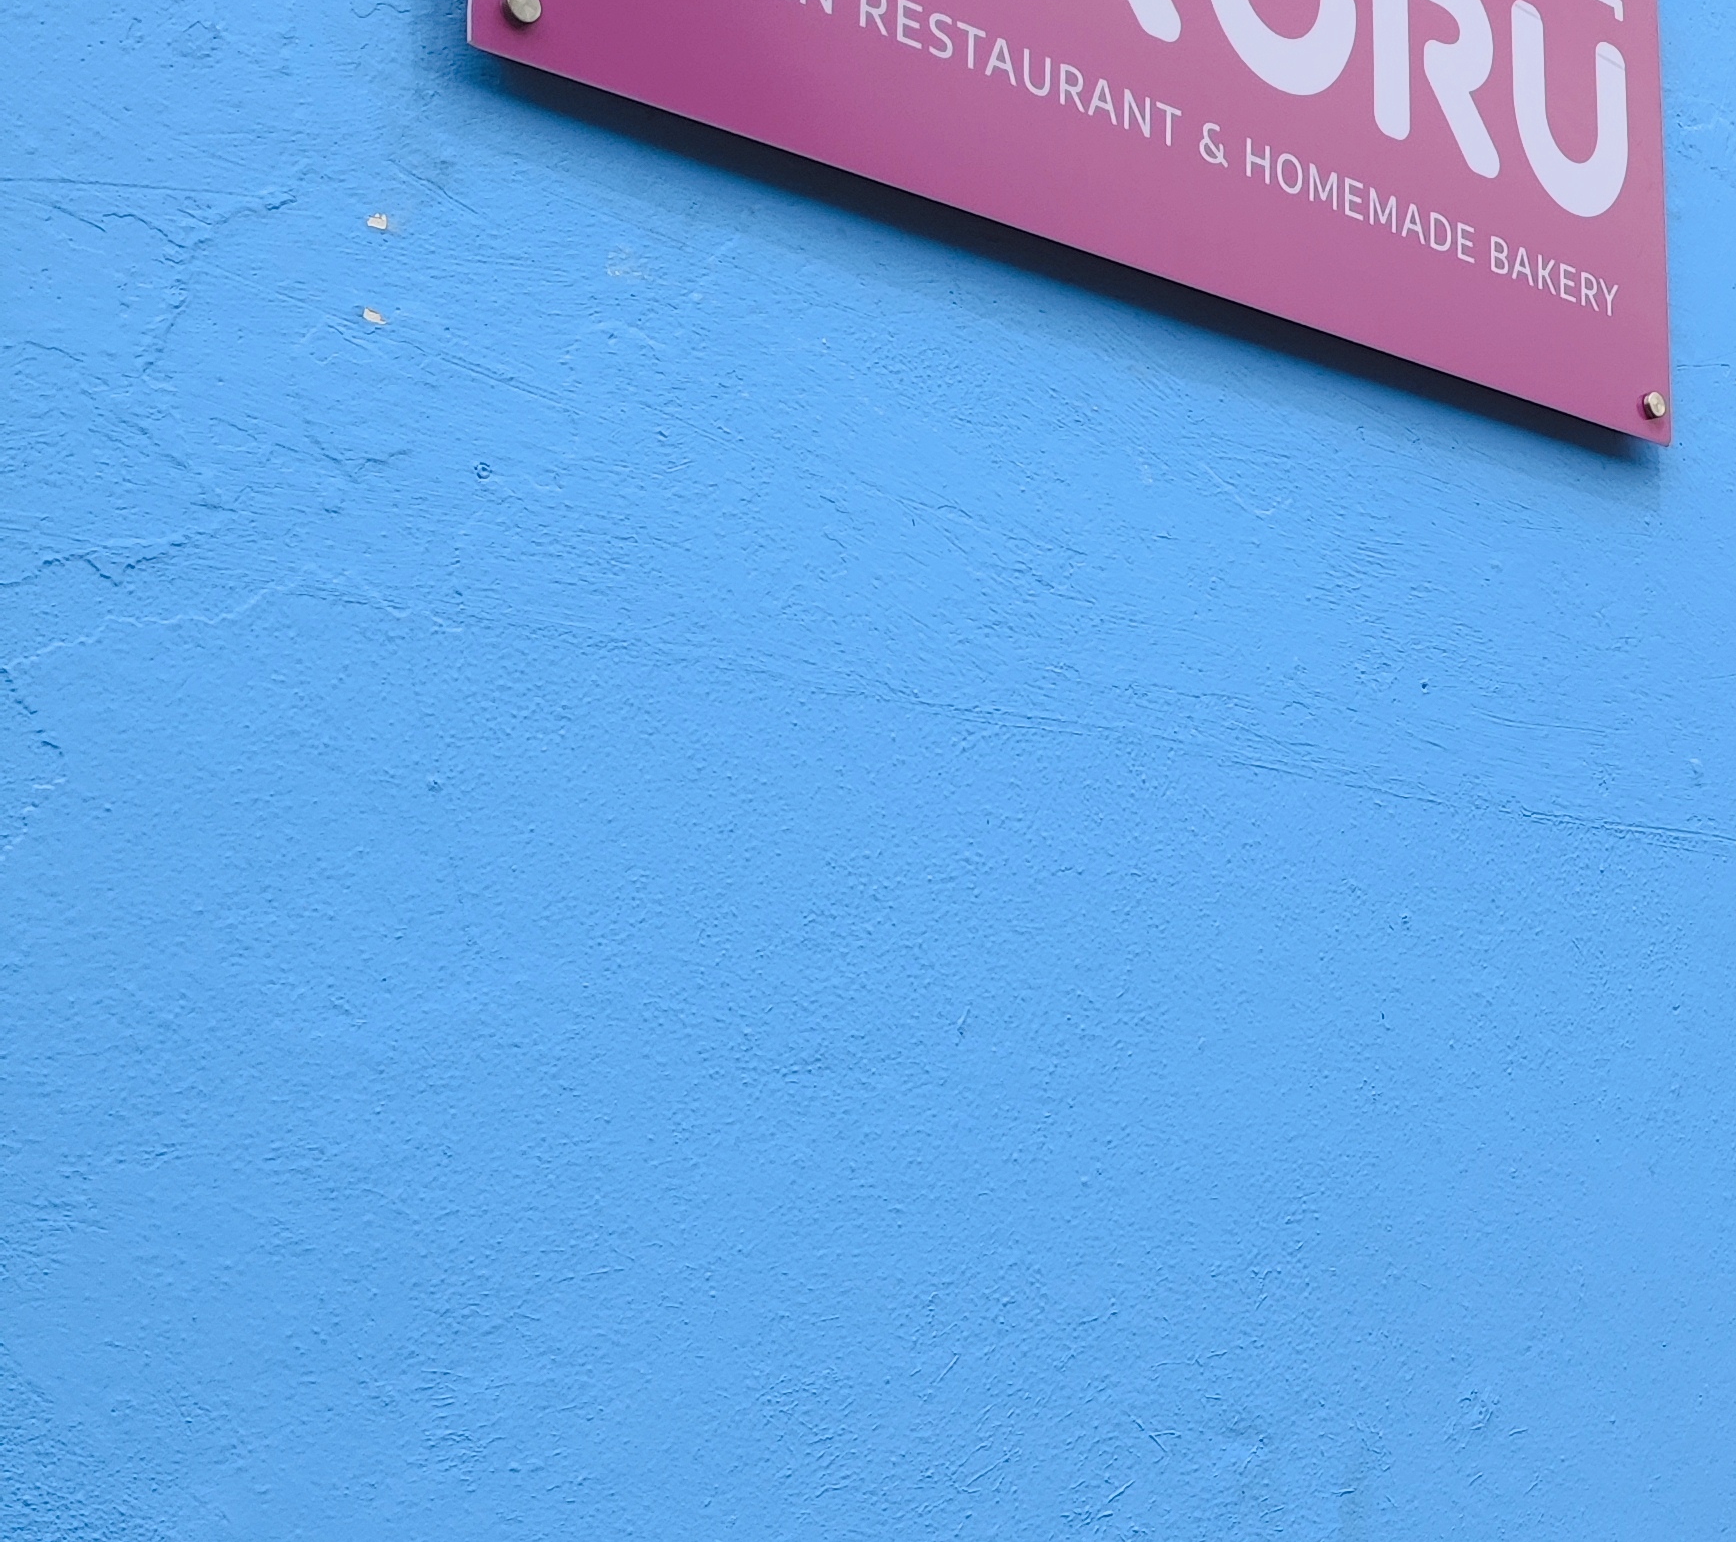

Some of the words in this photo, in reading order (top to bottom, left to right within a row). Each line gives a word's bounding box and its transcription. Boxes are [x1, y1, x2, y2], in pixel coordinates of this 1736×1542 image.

[1199, 122, 1230, 170] &
[1244, 136, 1477, 265] HOMEMADE
[1489, 234, 1620, 318] BAKERY
